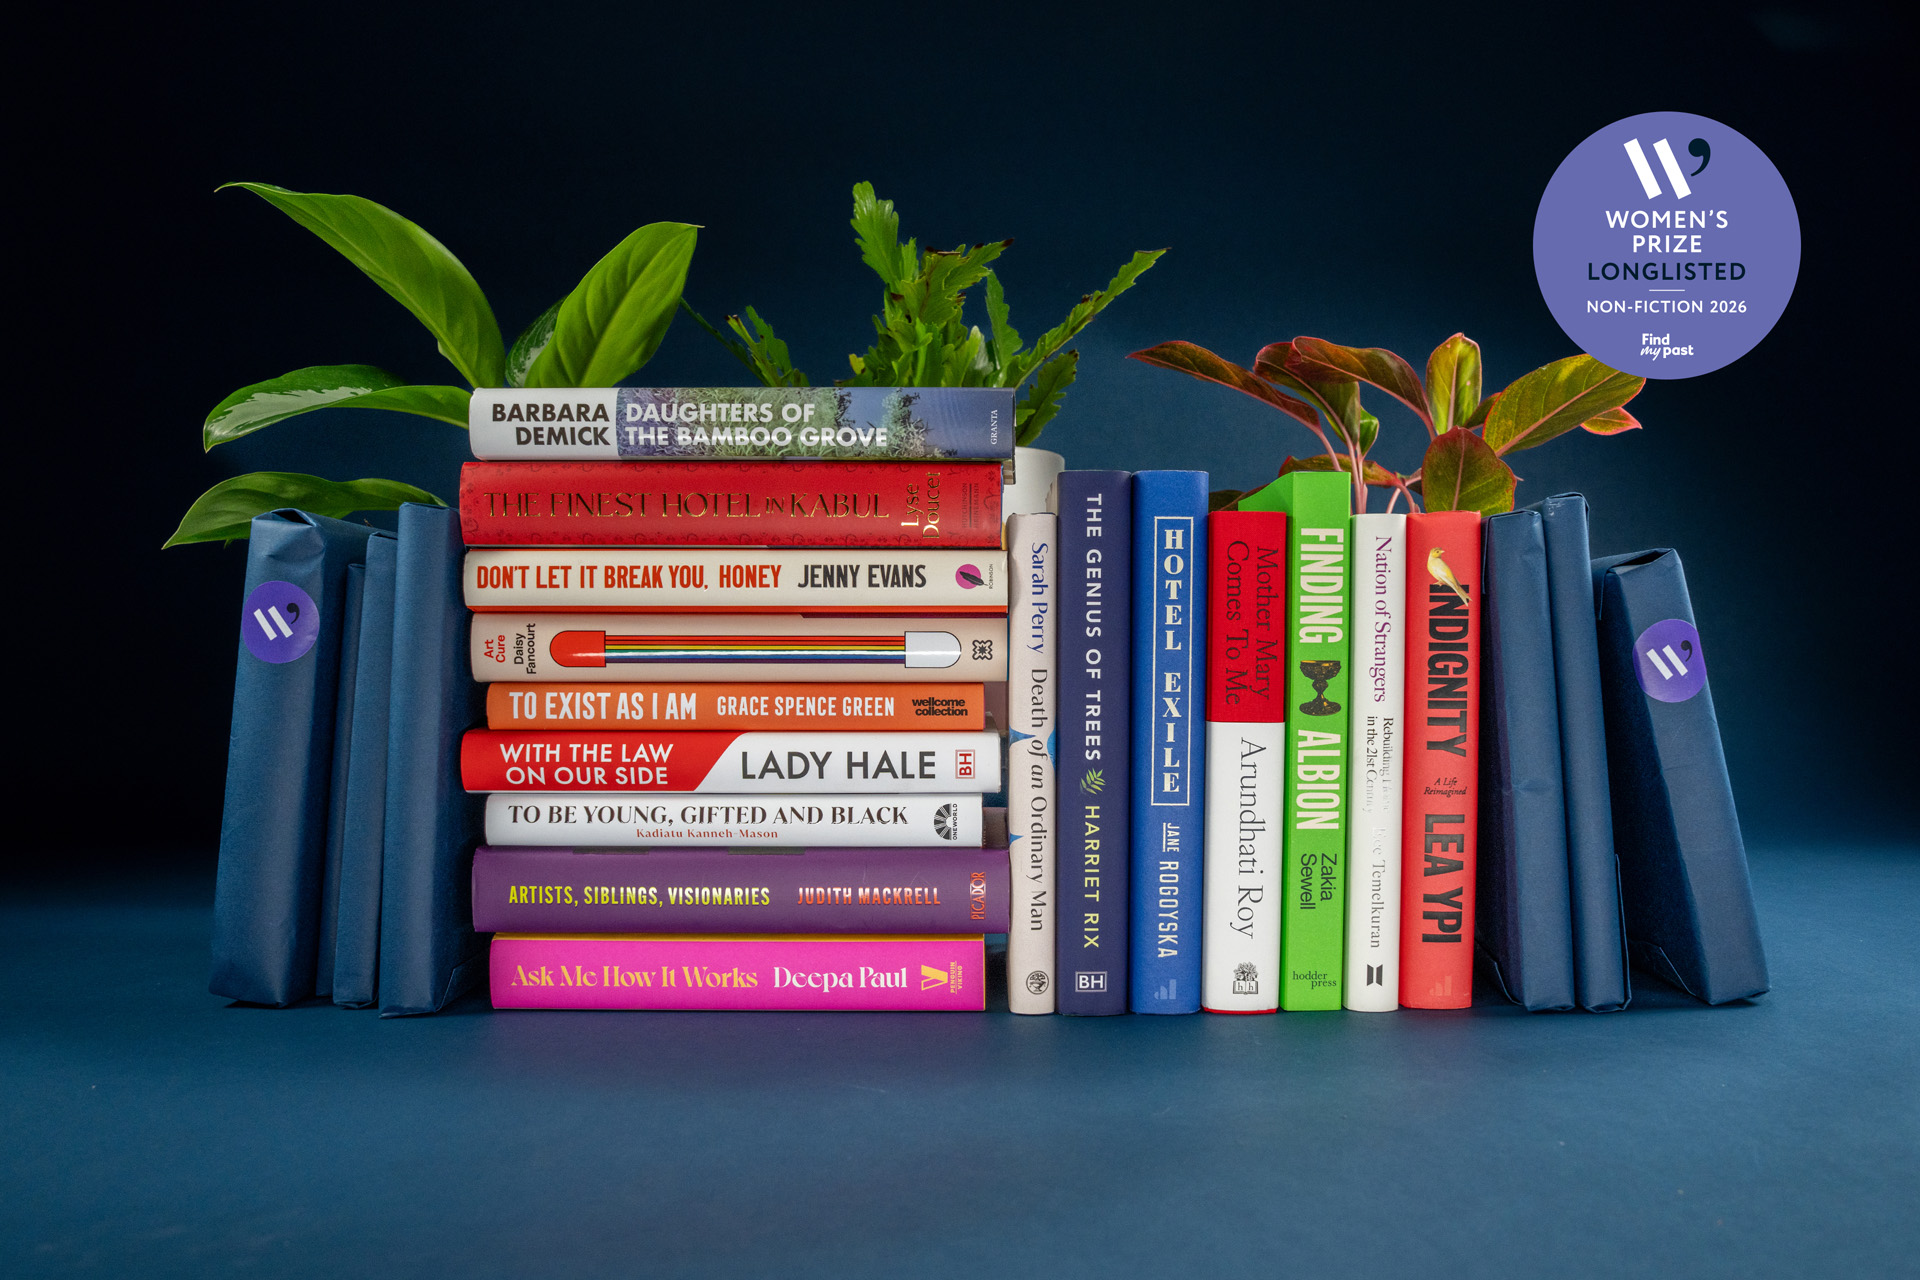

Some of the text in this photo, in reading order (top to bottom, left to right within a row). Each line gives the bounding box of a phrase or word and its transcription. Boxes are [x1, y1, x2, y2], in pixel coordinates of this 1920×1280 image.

[492, 403, 610, 422] BARBARA
[626, 403, 815, 422] DAUGHTERS OF
[516, 427, 611, 445] DEMICK
[625, 427, 888, 446] THE BAMBOO GROVE
[990, 409, 998, 445] GRANTA
[484, 492, 890, 518] THE FINEST HOTEL IN KABUL
[901, 483, 924, 527] Lyse
[922, 471, 940, 539] Doucet
[477, 565, 782, 590] DON'T LET IT BREAK YOU, HONEY
[798, 564, 927, 588] JENNY EVANS
[1026, 542, 1048, 654] Sarah Perry
[1085, 493, 1102, 761] THE GENIUS OF TREES
[1226, 540, 1250, 705] Comes To Me
[1249, 546, 1279, 700] Mother Mary
[1369, 536, 1393, 703] Nation of Strangers
[484, 639, 494, 658] Art
[495, 634, 506, 663] Cure
[514, 633, 527, 665] Daisy
[526, 623, 537, 675] Fancourt
[1162, 529, 1184, 793] HOTEL EXILE
[1296, 528, 1345, 830] FINDING ALBION
[1426, 584, 1470, 758] INDIGNITY
[509, 691, 696, 720] TO EXIST AS I AM
[717, 696, 894, 716] GRACE SPENCE GREEN
[912, 697, 966, 707] wellcome
[915, 705, 968, 716] collection
[1367, 716, 1378, 726] in
[1366, 728, 1378, 746] the
[1379, 718, 1394, 777] Rebuilding
[500, 744, 674, 763] WITH THE LAW
[741, 750, 936, 779] LADY HALE
[959, 752, 972, 776] BH
[1366, 747, 1378, 767] 21st
[505, 766, 668, 785] ON OUR SIDE
[1434, 777, 1458, 788] A Life
[1026, 669, 1048, 931] Death of an Ordinary Man
[1423, 786, 1468, 798] Reimagined
[508, 805, 909, 826] TO BE YOUNG, GIFTED AND BLACK
[636, 828, 778, 839] Kadiatu Kanneh-Mason
[1230, 737, 1267, 939] Arundhati Roy
[1084, 805, 1100, 948] HARRIET RIX
[1300, 853, 1317, 910] Sewell
[1320, 853, 1337, 902] Zakia
[1422, 814, 1465, 943] LEA YPI
[509, 885, 770, 908] ARTISTS, SIBLINGS, VISIONARIES
[797, 887, 941, 906] JUDITH MACKRELL
[971, 872, 985, 920] PICADOR
[1158, 822, 1180, 958] JANE ROGOYSKA
[1371, 860, 1386, 948] Temelkuran
[511, 965, 758, 988] Ask Me How It Works
[774, 966, 908, 993] Deepa Paul
[1079, 975, 1104, 989] BH
[1293, 971, 1328, 980] hodder
[1311, 980, 1337, 990] press
